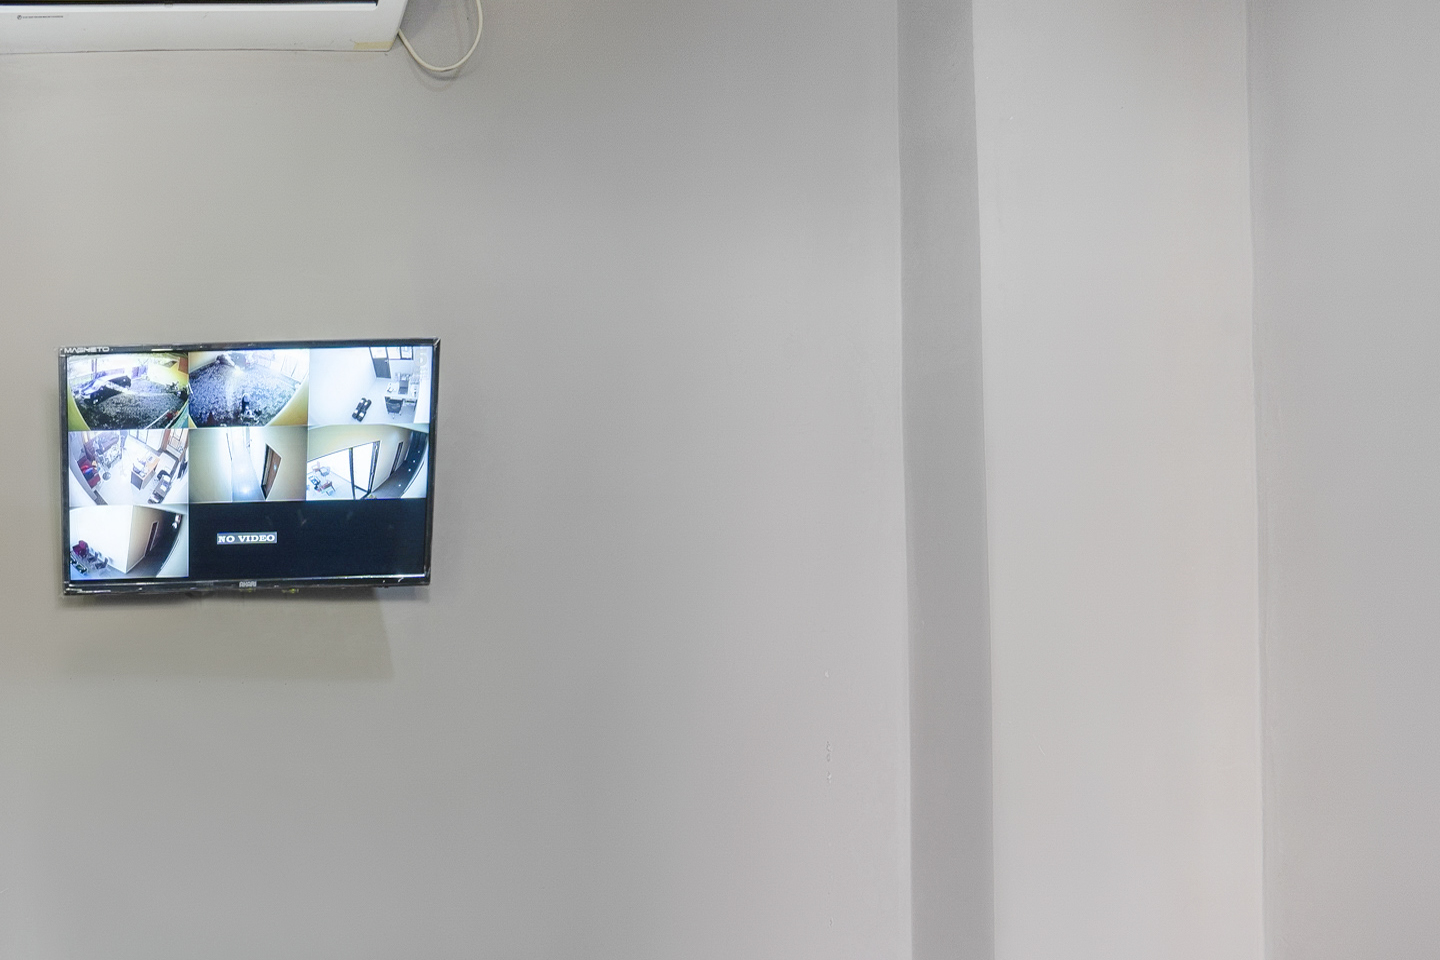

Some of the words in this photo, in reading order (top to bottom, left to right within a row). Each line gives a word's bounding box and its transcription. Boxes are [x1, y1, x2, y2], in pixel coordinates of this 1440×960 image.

[64, 346, 110, 354] MAGNETO
[218, 535, 235, 543] NO
[237, 534, 276, 543] VIDEO
